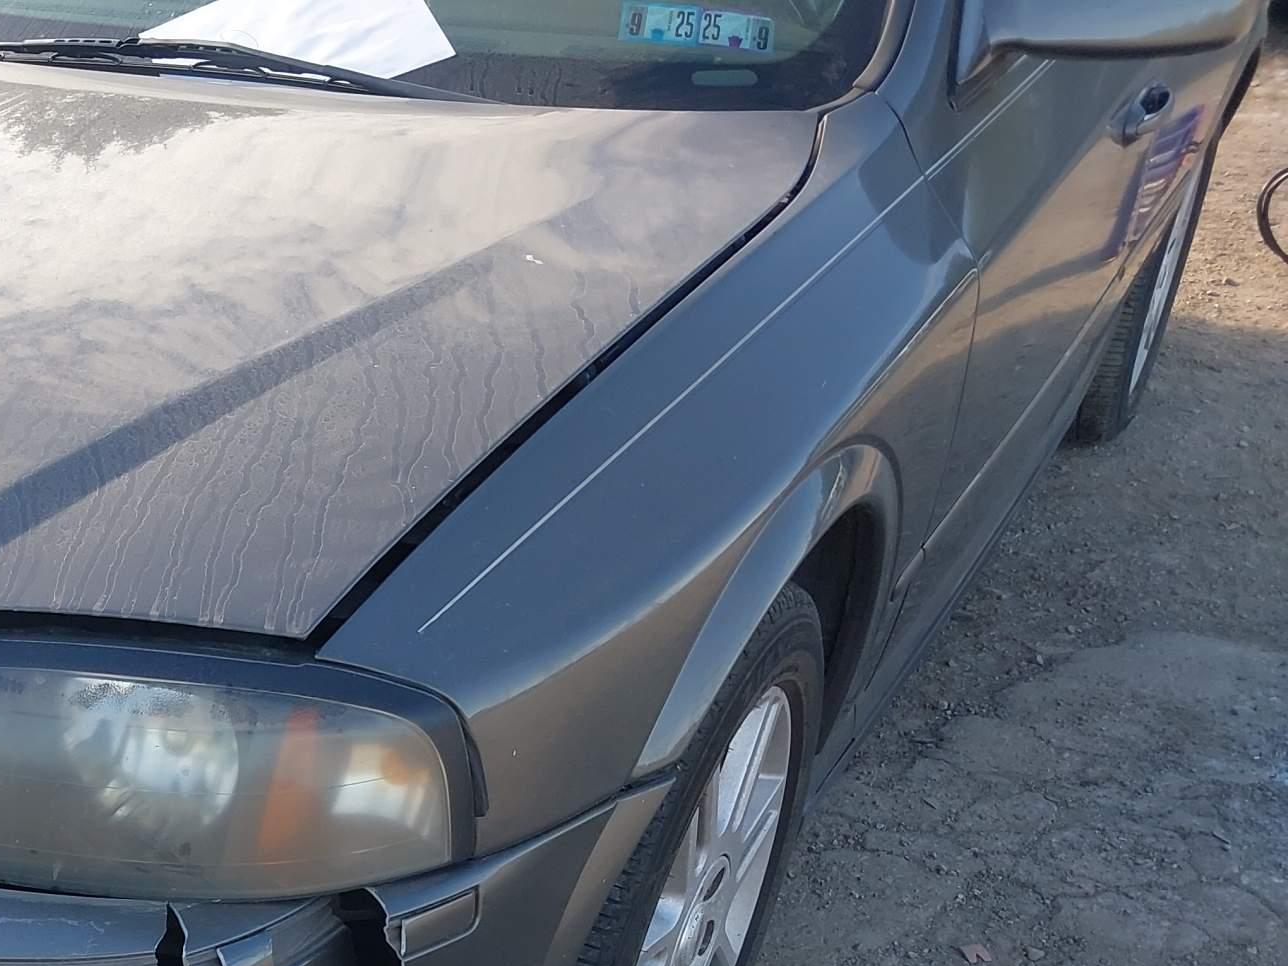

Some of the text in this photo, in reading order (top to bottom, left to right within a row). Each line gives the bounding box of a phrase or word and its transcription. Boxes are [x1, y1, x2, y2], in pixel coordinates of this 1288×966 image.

[629, 12, 643, 36] 9
[674, 11, 696, 38] 25
[702, 13, 722, 41] 25
[756, 26, 770, 50] 9
